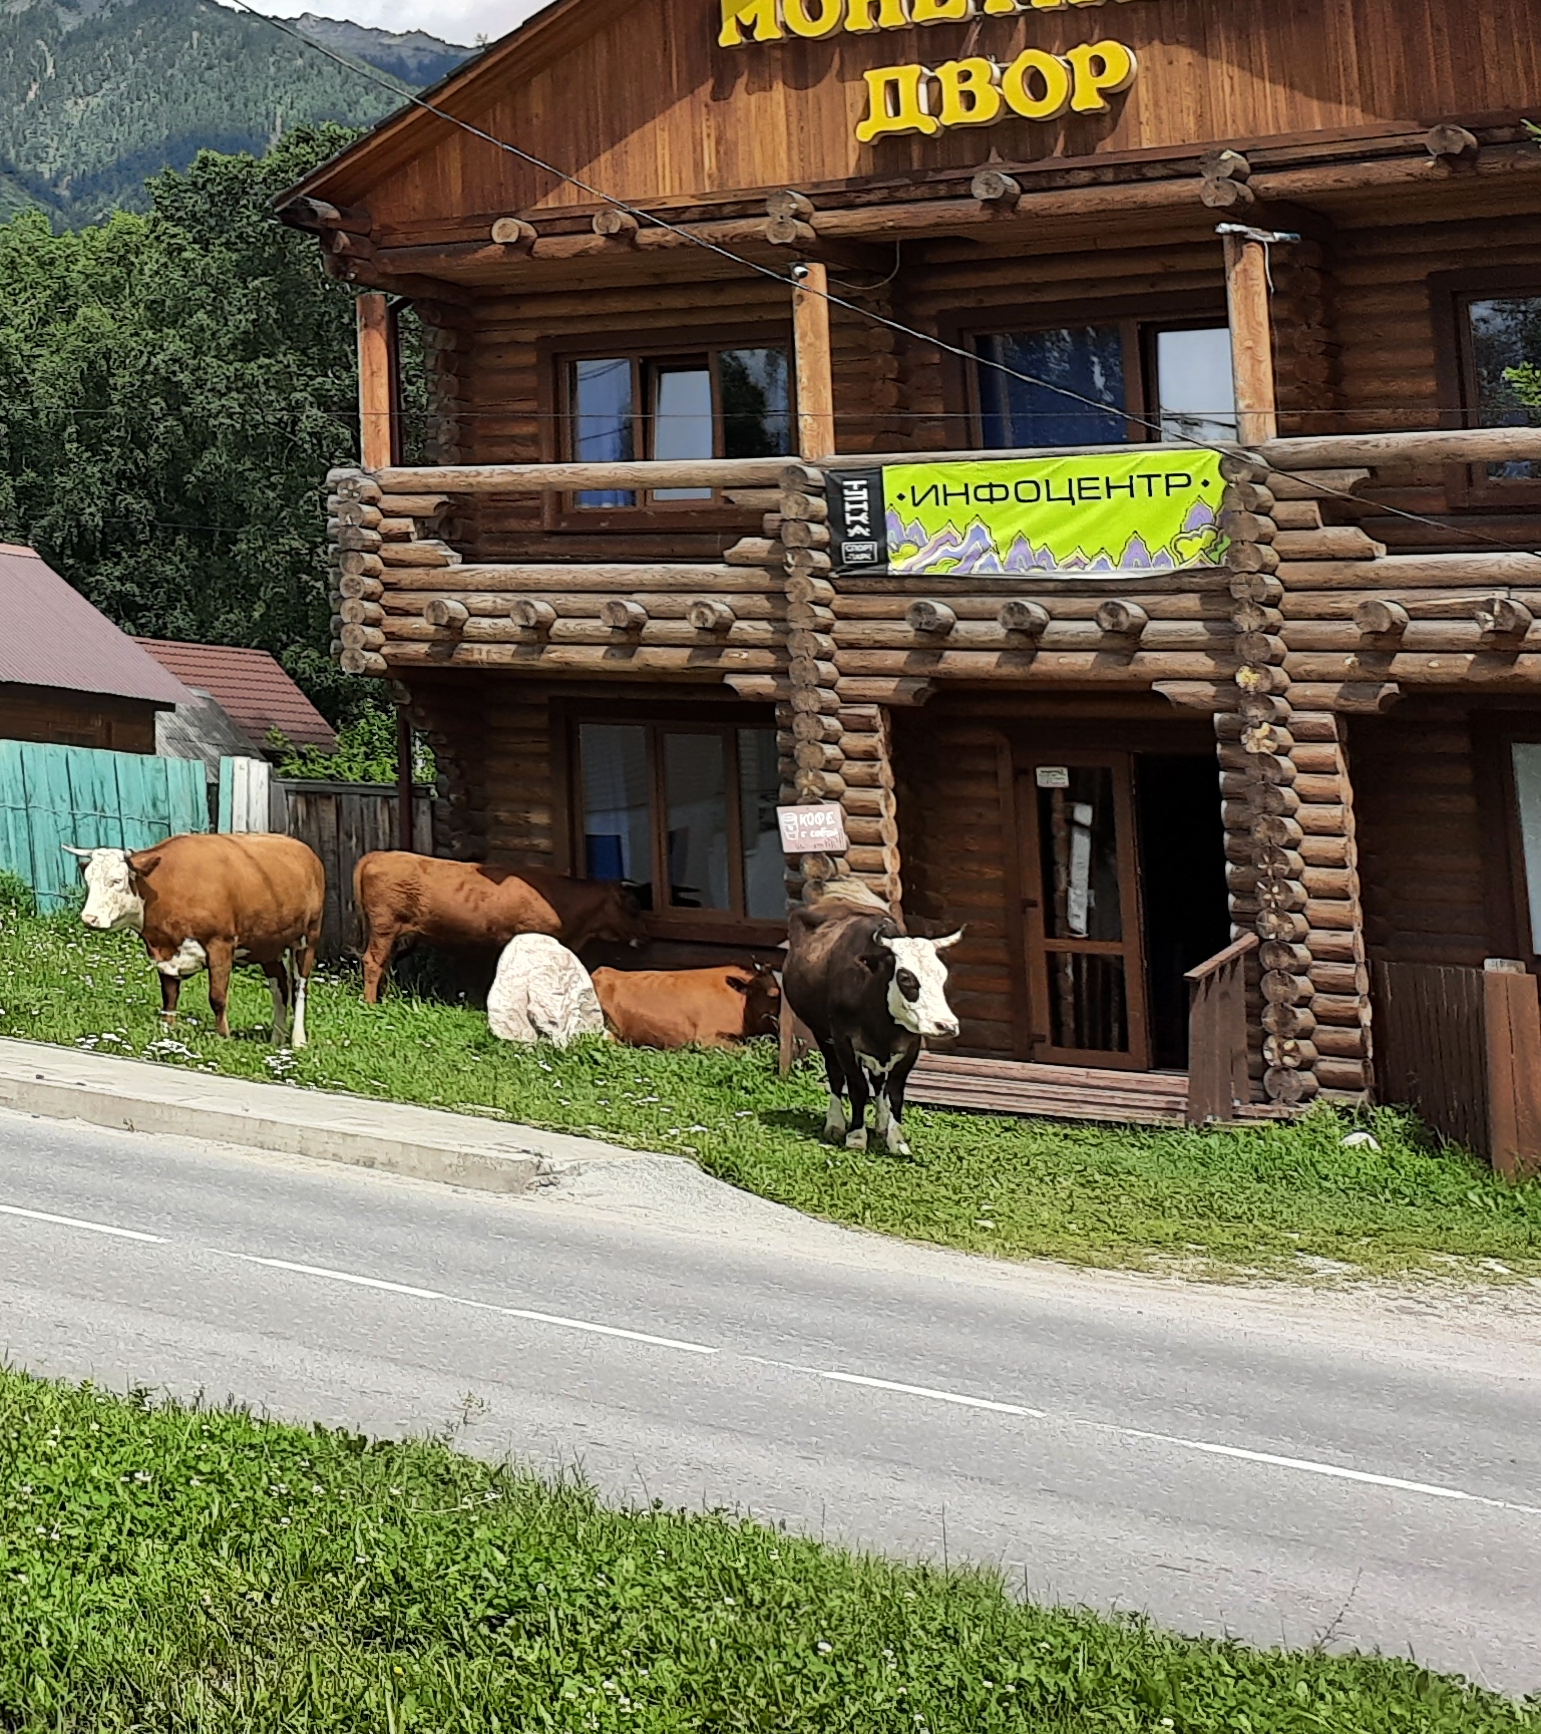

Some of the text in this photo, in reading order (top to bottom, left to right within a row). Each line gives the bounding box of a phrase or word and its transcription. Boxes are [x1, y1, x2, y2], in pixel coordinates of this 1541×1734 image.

[855, 40, 1138, 144] ДВОР
[910, 472, 1192, 507] ИНФОЦЕНТР
[799, 811, 835, 827] КОФЕ
